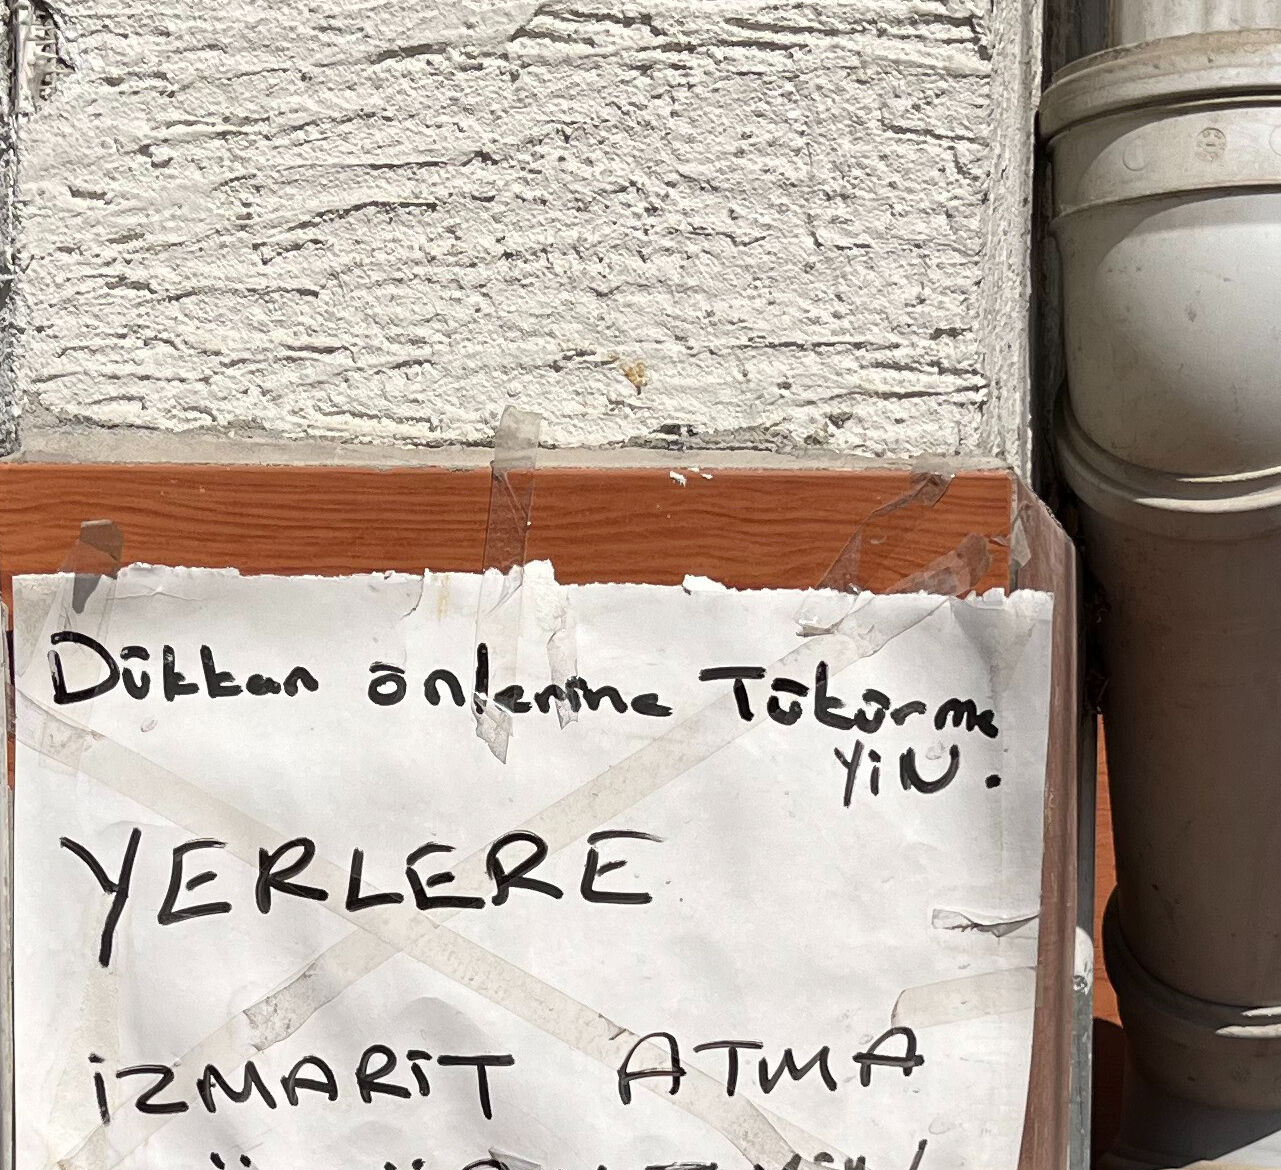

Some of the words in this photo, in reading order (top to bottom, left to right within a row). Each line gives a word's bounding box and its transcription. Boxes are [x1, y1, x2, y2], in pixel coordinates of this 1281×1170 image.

[51, 630, 319, 705] Dükkan
[698, 660, 999, 739] Tükürme
[61, 828, 662, 968] YERLERE
[618, 1027, 925, 1106] ATMA
